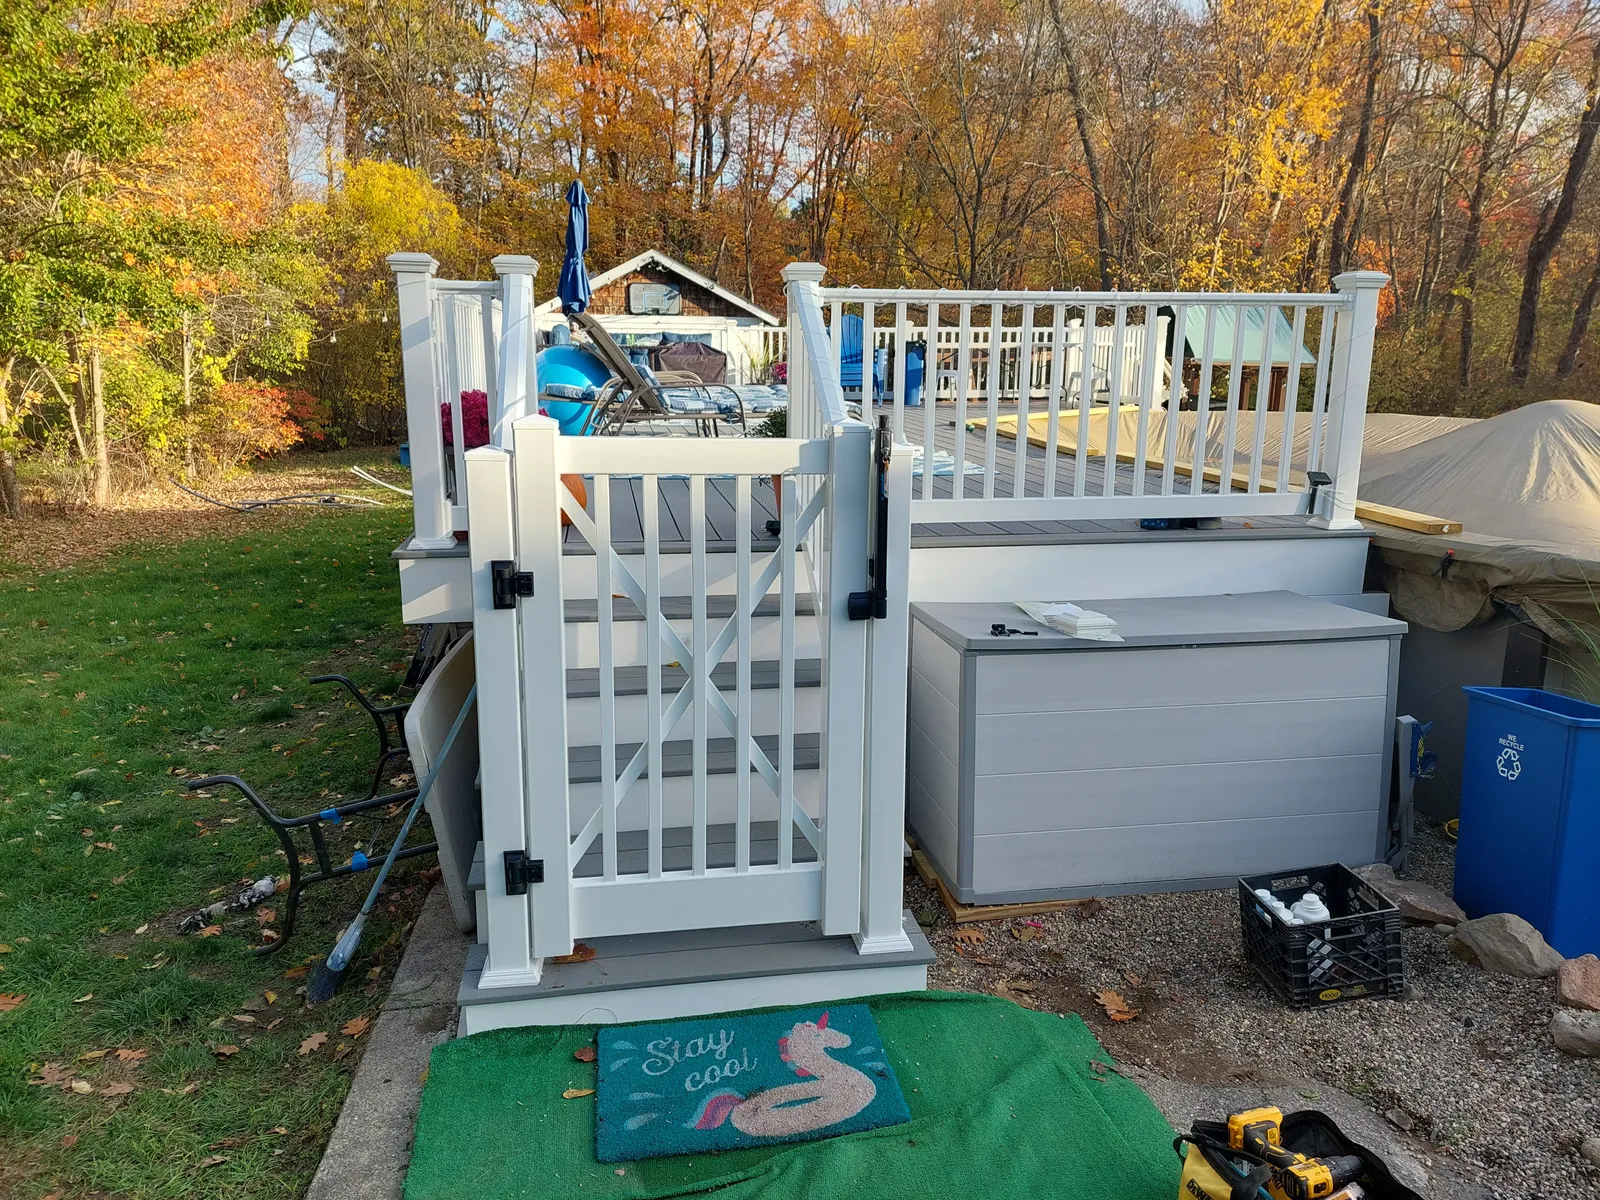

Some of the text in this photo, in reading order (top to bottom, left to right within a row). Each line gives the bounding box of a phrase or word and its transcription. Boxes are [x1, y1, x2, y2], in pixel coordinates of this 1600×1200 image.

[1498, 738, 1525, 751] RECYCLE
[1507, 734, 1517, 742] WE
[642, 1029, 734, 1075] Stay
[685, 1047, 758, 1092] cool
